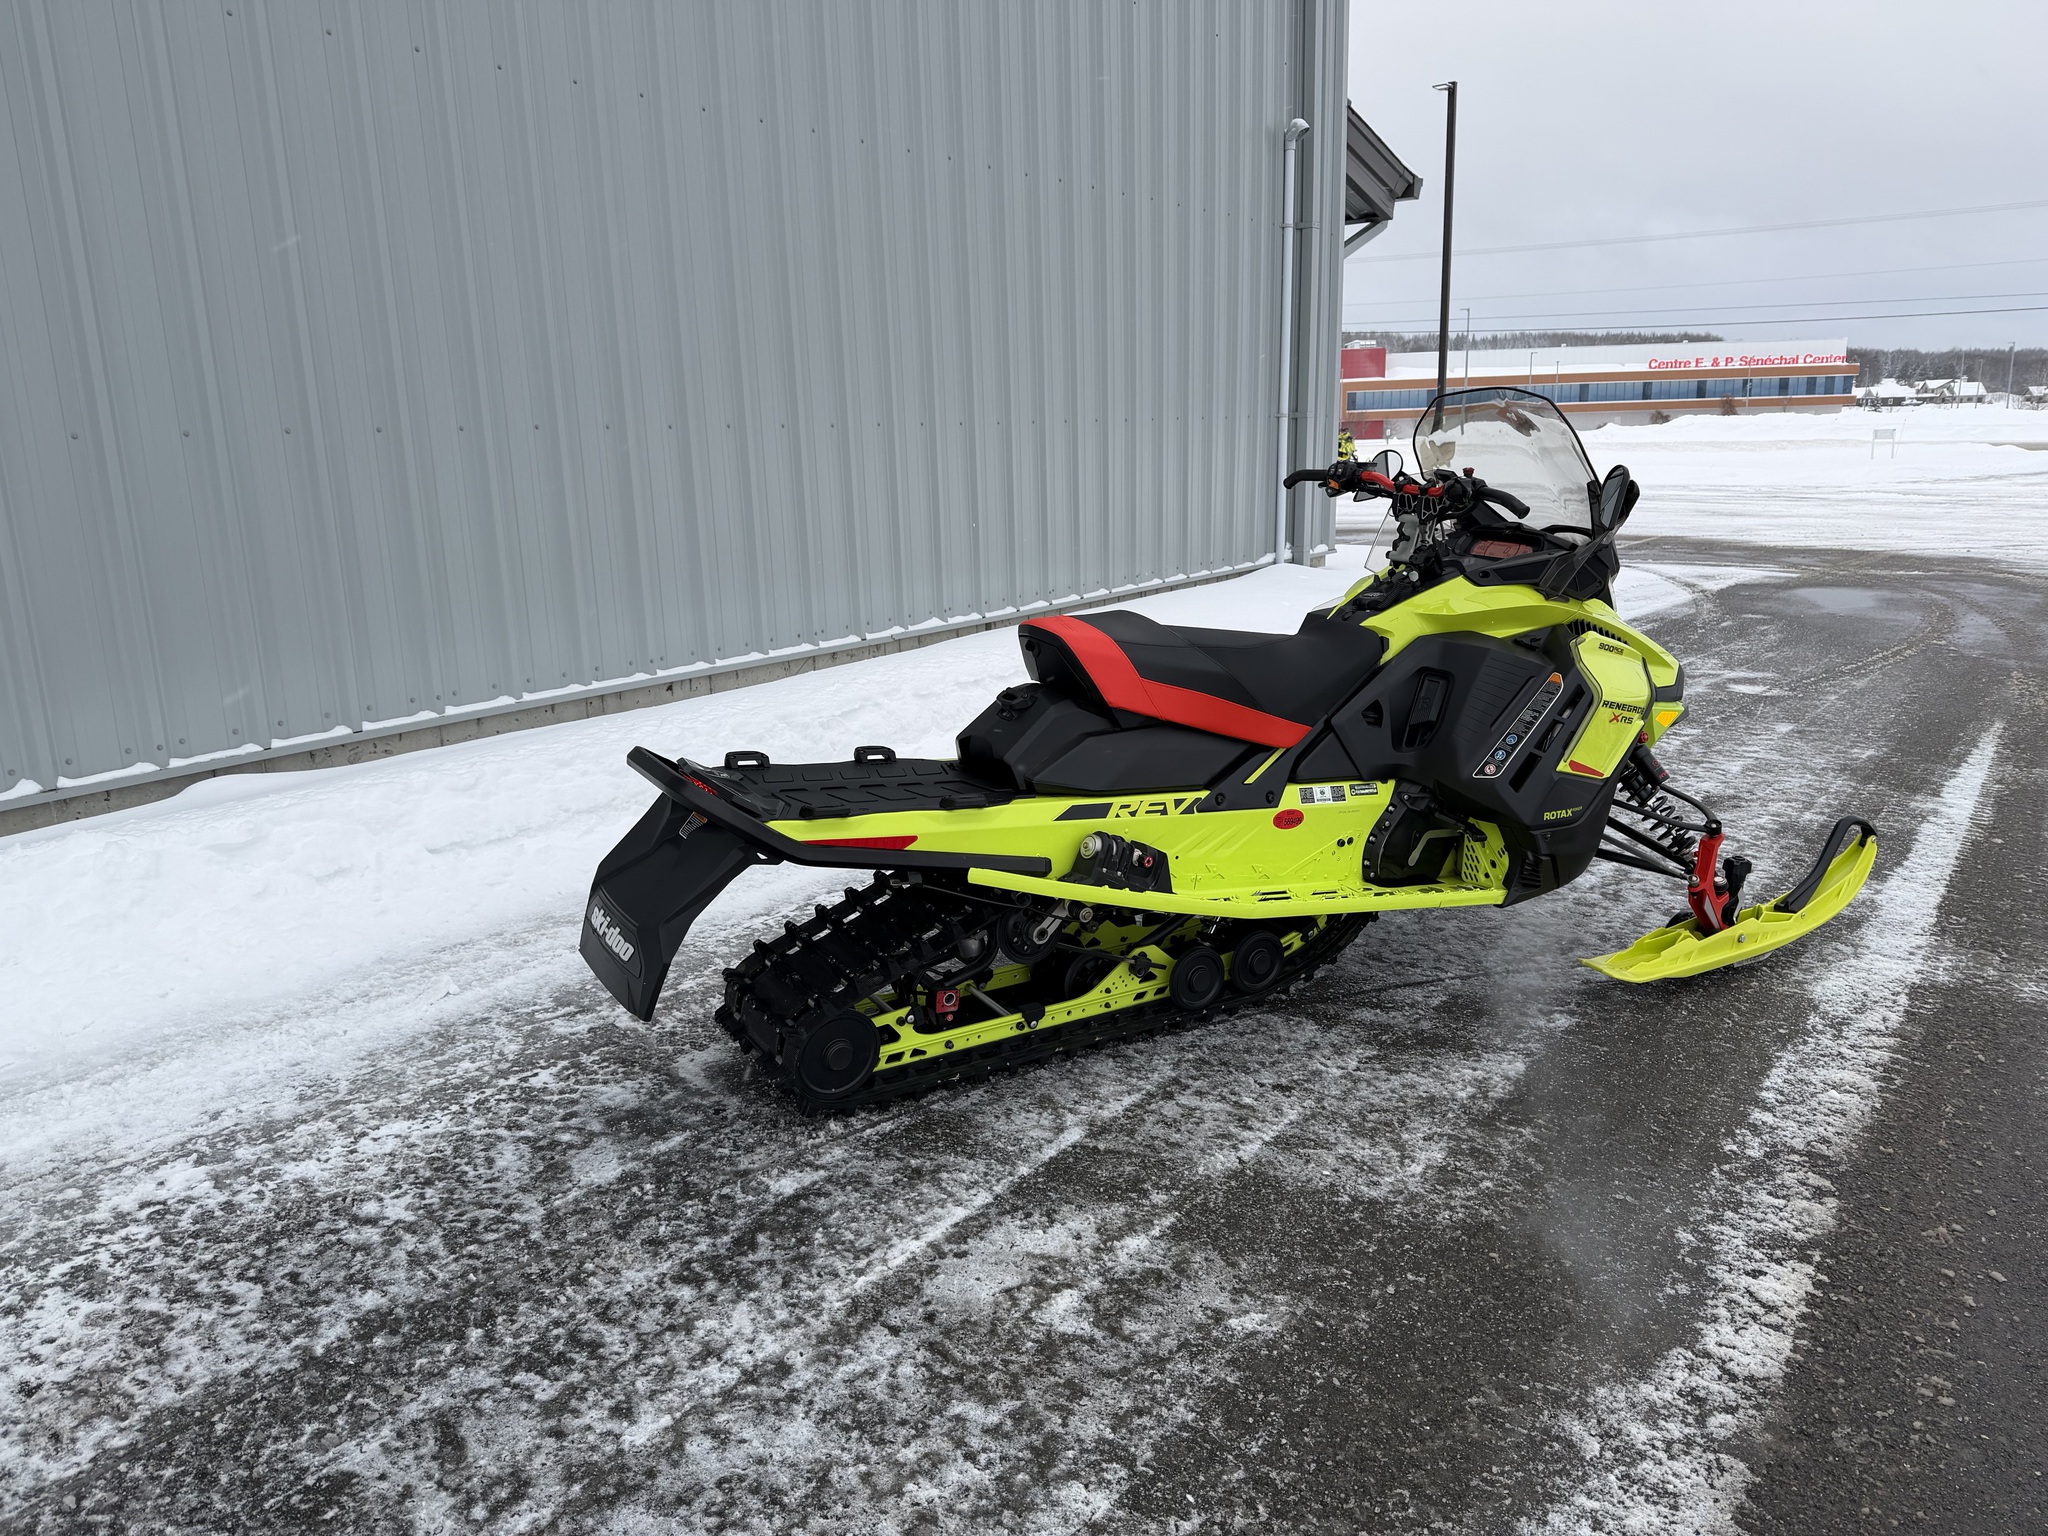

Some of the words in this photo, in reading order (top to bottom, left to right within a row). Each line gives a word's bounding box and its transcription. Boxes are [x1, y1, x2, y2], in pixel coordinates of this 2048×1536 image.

[1648, 358, 1692, 369] Centre
[1695, 357, 1708, 368] E.
[1711, 356, 1721, 367] &
[1724, 356, 1736, 367] P.
[1739, 354, 1800, 366] Sénéchal
[1803, 353, 1847, 364] Center
[1598, 642, 1615, 652] 900
[1105, 798, 1197, 819] REV
[1543, 808, 1573, 820] ROTAX
